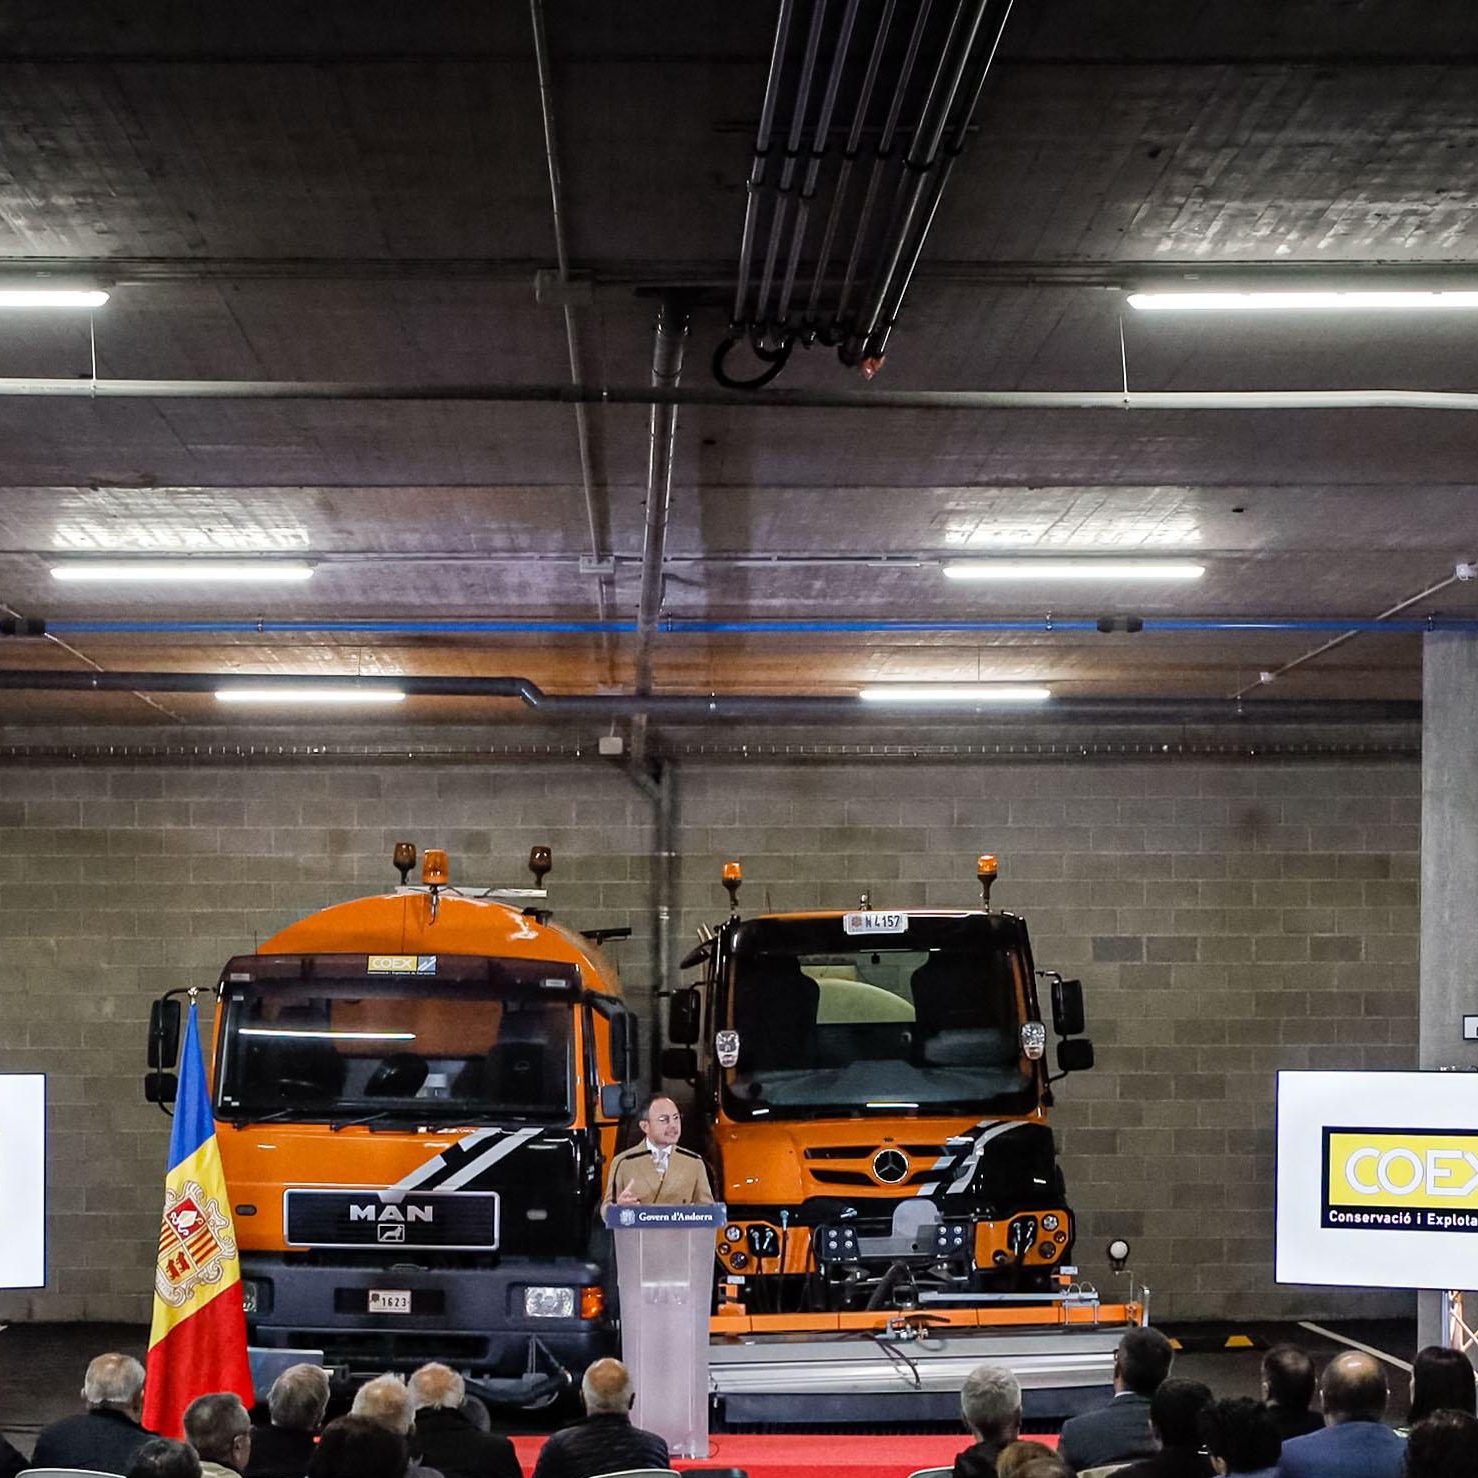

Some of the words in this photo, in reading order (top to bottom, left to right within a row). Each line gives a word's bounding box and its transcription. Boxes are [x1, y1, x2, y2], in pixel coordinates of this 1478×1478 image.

[372, 958, 412, 969] COEX
[349, 1204, 433, 1222] MAN
[638, 1212, 670, 1221] Govern
[671, 1212, 713, 1221] d'Andorra
[1329, 1210, 1412, 1225] Conservació
[1416, 1212, 1421, 1225] i
[382, 1297, 407, 1307] 1623
